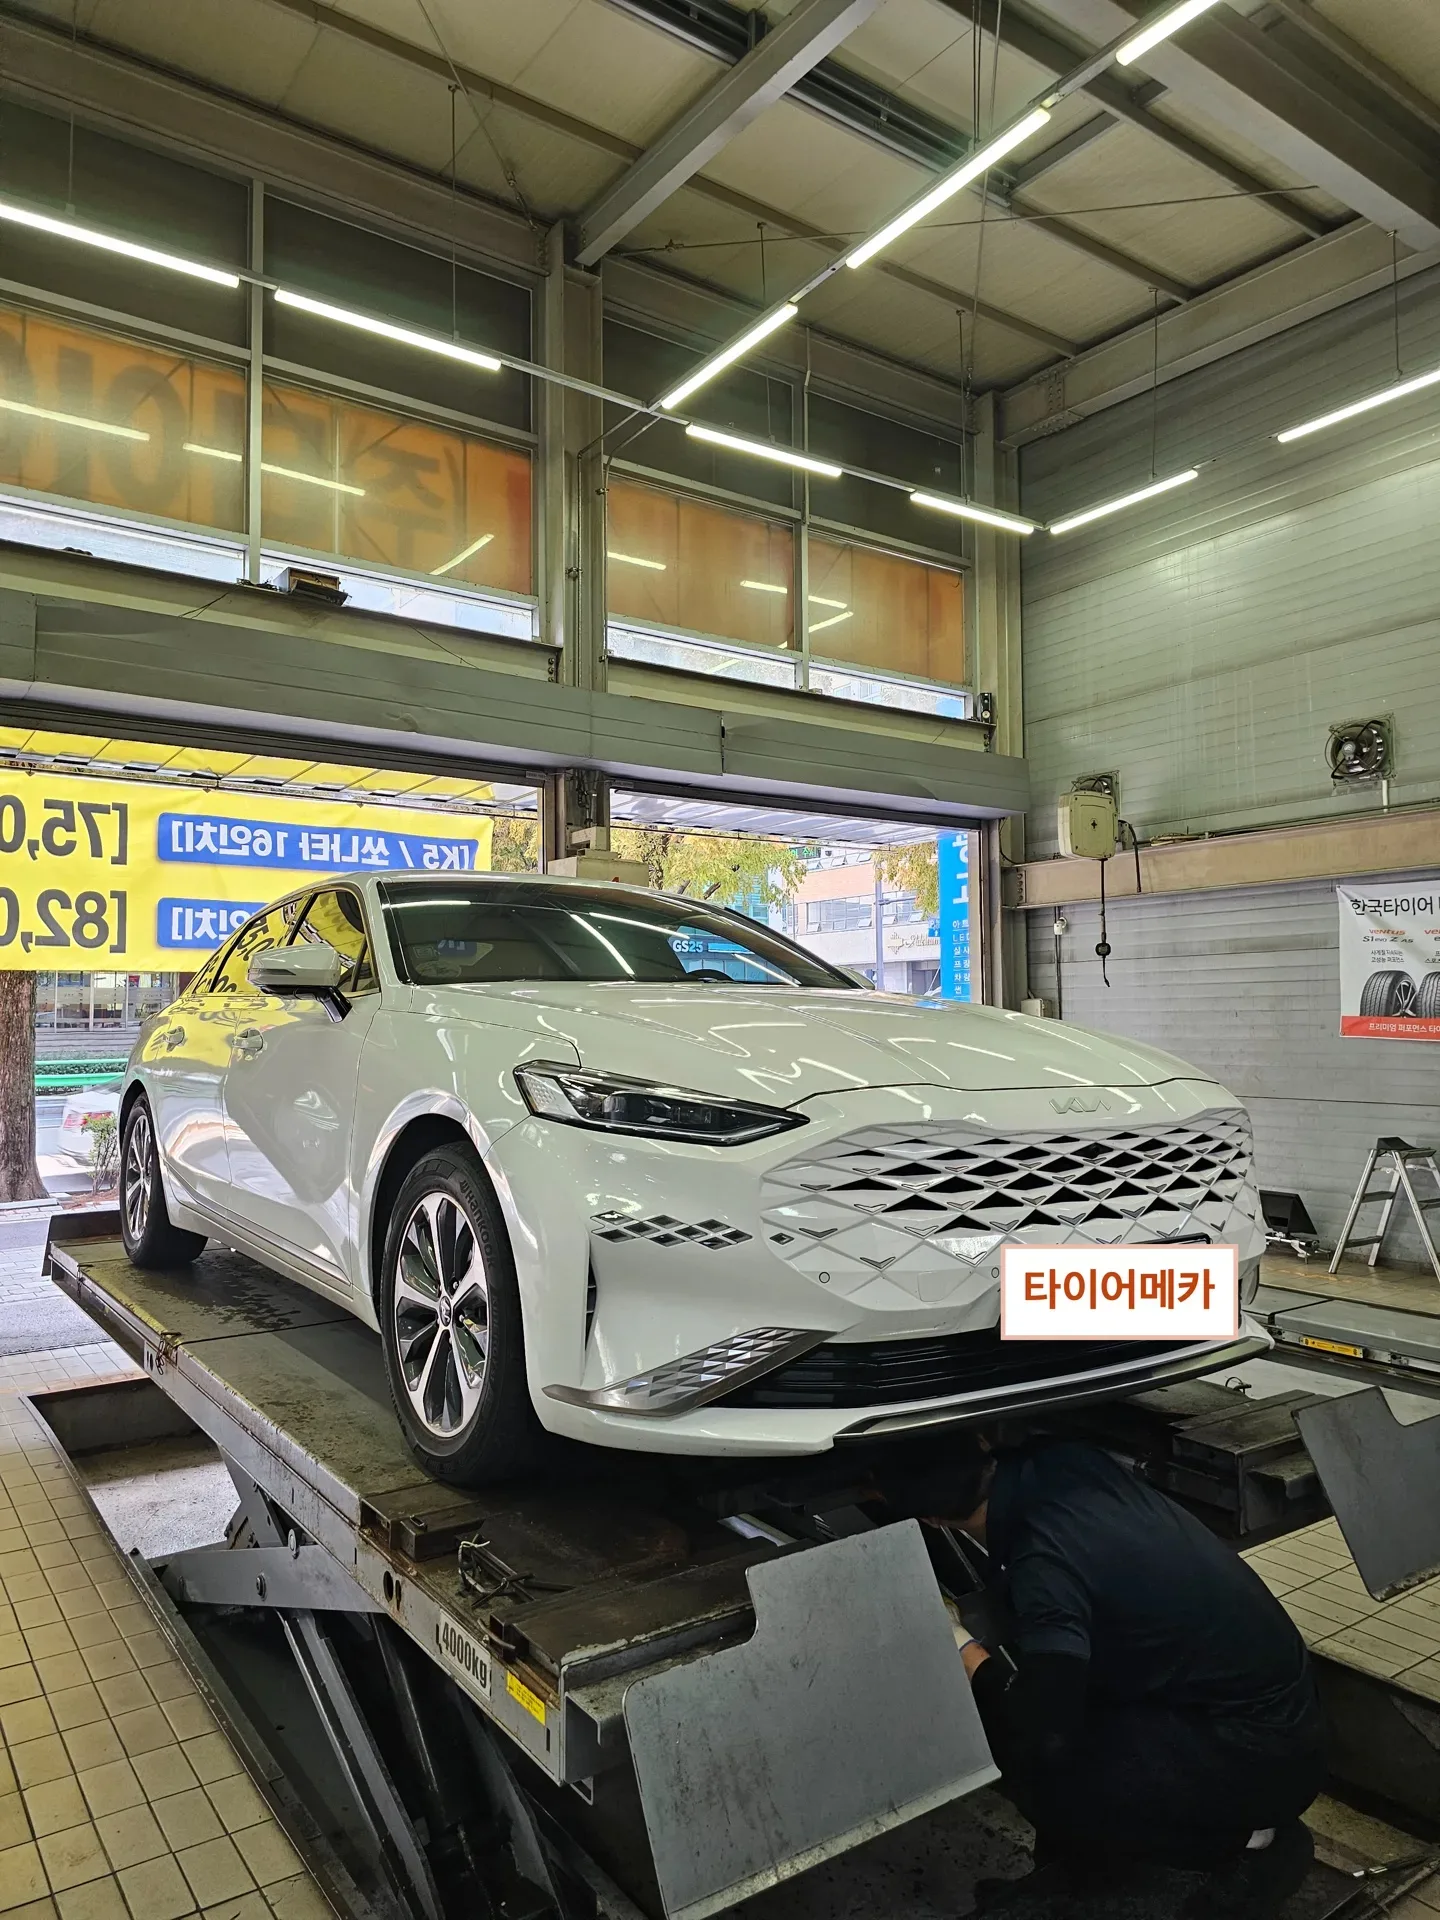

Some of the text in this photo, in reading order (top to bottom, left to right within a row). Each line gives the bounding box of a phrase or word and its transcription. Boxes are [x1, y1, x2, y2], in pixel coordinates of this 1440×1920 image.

[1351, 896, 1434, 917] 한국타이어
[672, 940, 704, 952] GS25
[1368, 1023, 1397, 1032] 프리미엄
[1398, 1024, 1428, 1033] 퍼포먼스
[441, 1621, 488, 1689] 4000kg
